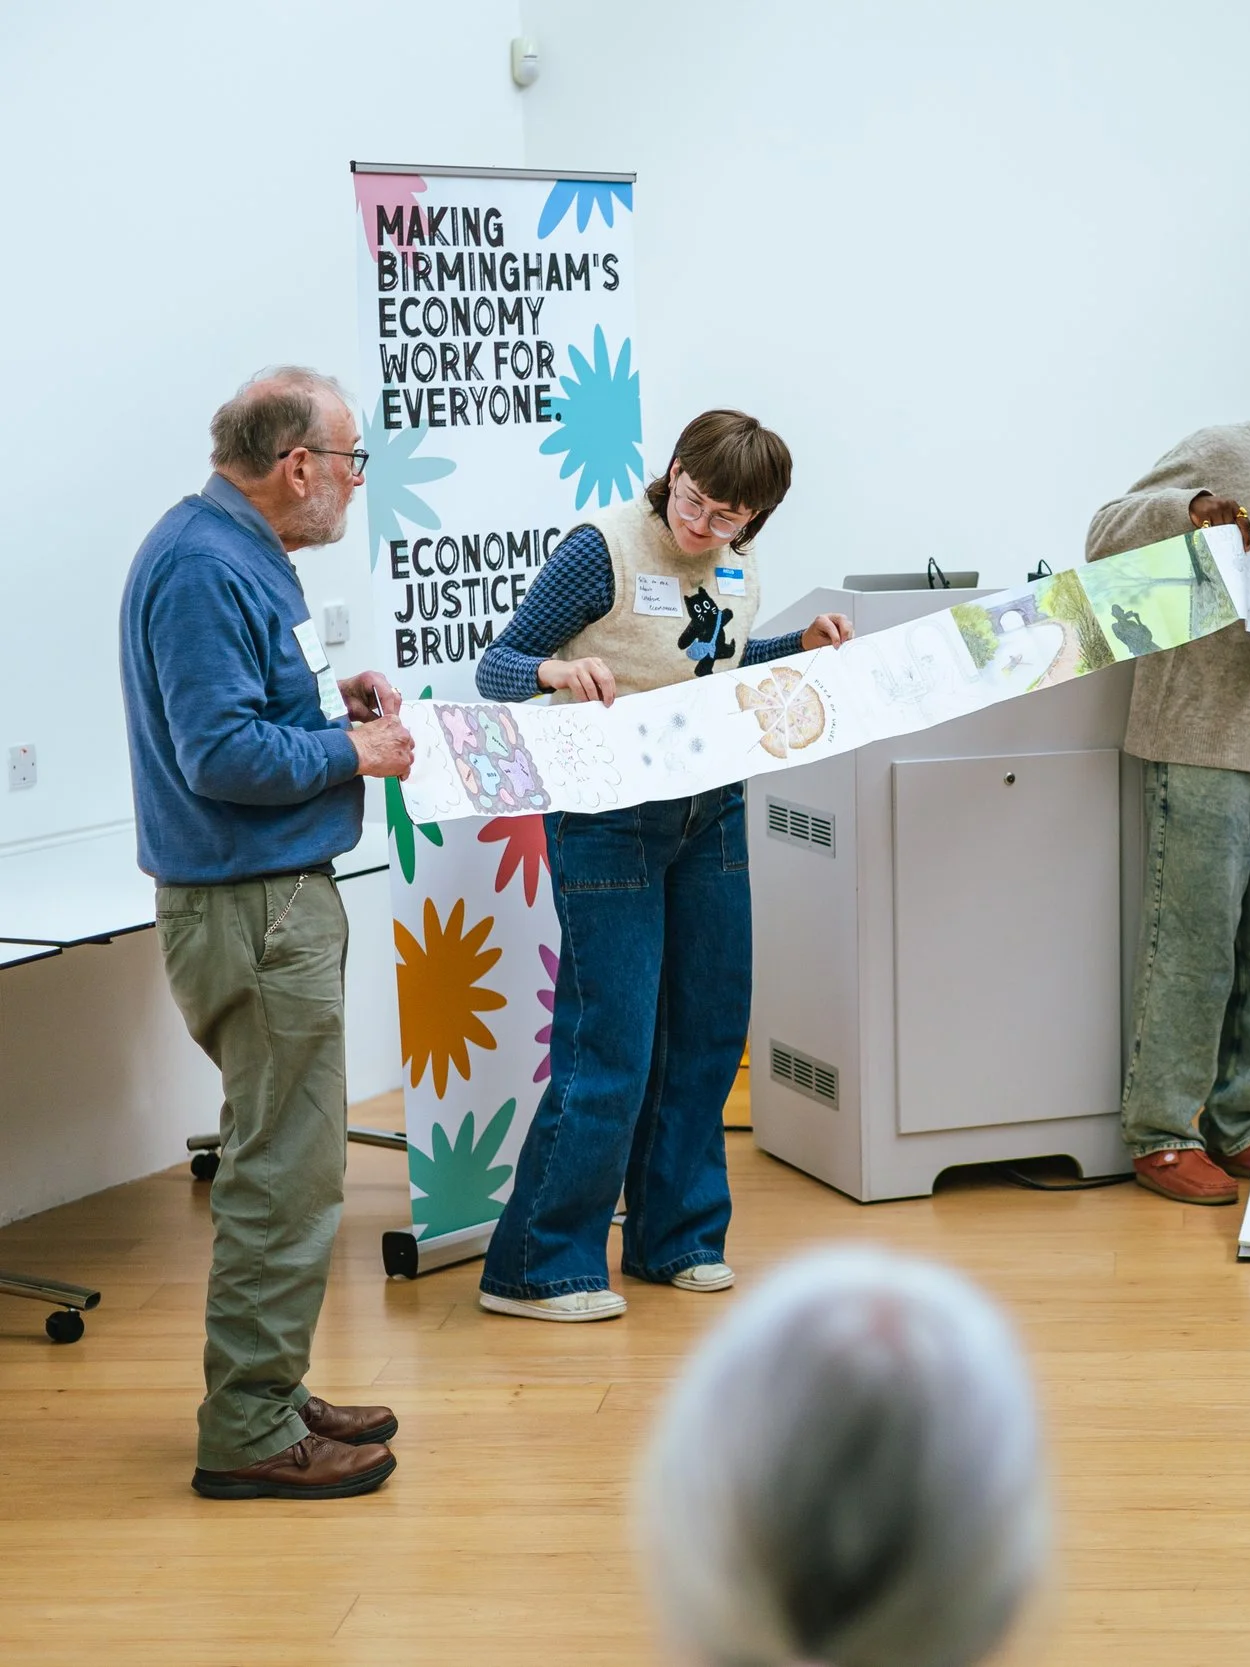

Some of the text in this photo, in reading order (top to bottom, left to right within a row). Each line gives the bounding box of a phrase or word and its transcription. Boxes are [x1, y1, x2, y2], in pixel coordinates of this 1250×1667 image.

[376, 205, 504, 247] MAKING
[377, 251, 620, 292] BIRMINGHAM'S
[378, 296, 545, 338] ECONOMY
[379, 340, 556, 384] WORK FOR
[382, 384, 562, 430] EVERYONE.
[389, 528, 561, 580] ECONOMIC
[394, 574, 527, 623] JUSTICE
[395, 620, 494, 668] BRUM
